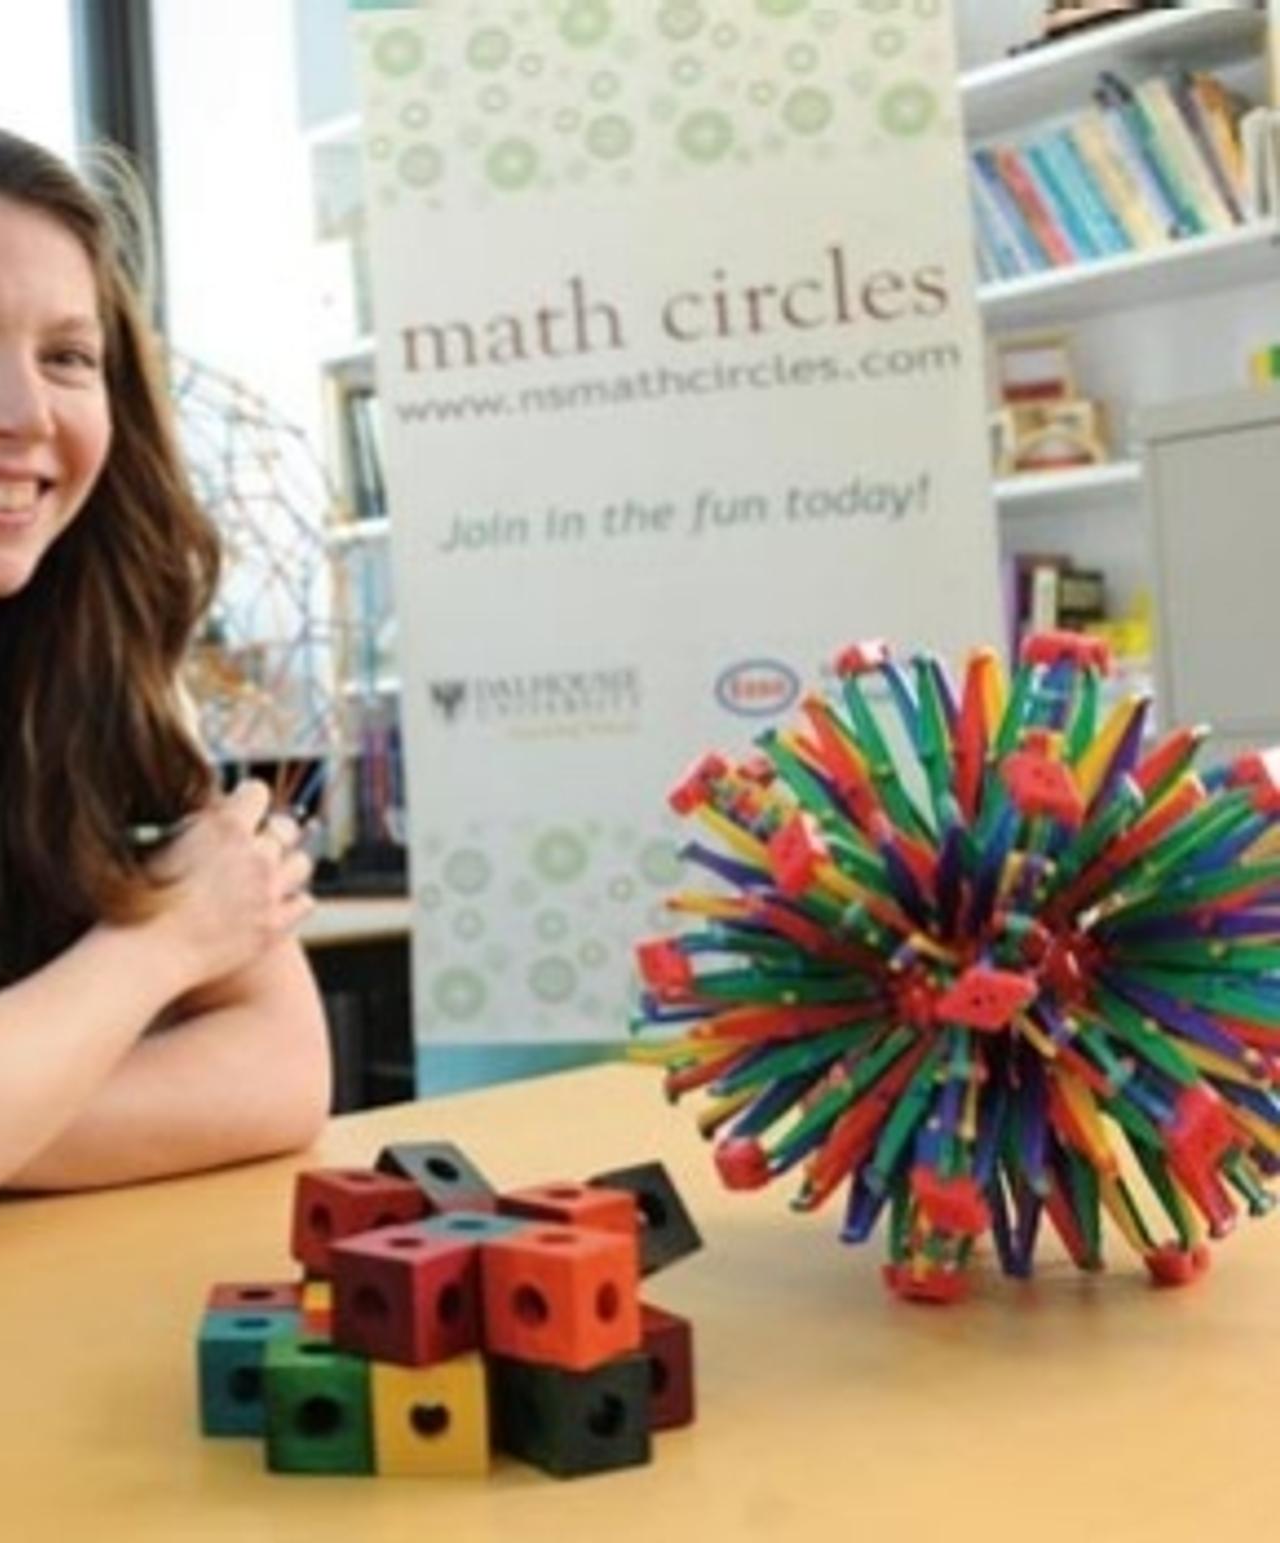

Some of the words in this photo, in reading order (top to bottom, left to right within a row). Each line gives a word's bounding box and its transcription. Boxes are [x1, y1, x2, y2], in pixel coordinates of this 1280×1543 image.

[402, 275, 626, 371] math
[662, 244, 951, 342] circles
[397, 341, 961, 423] www.nsmathcircles.com
[440, 512, 528, 553] Join
[546, 504, 585, 540] in
[601, 493, 676, 537] the
[690, 488, 770, 537] fun
[787, 475, 932, 521] today!
